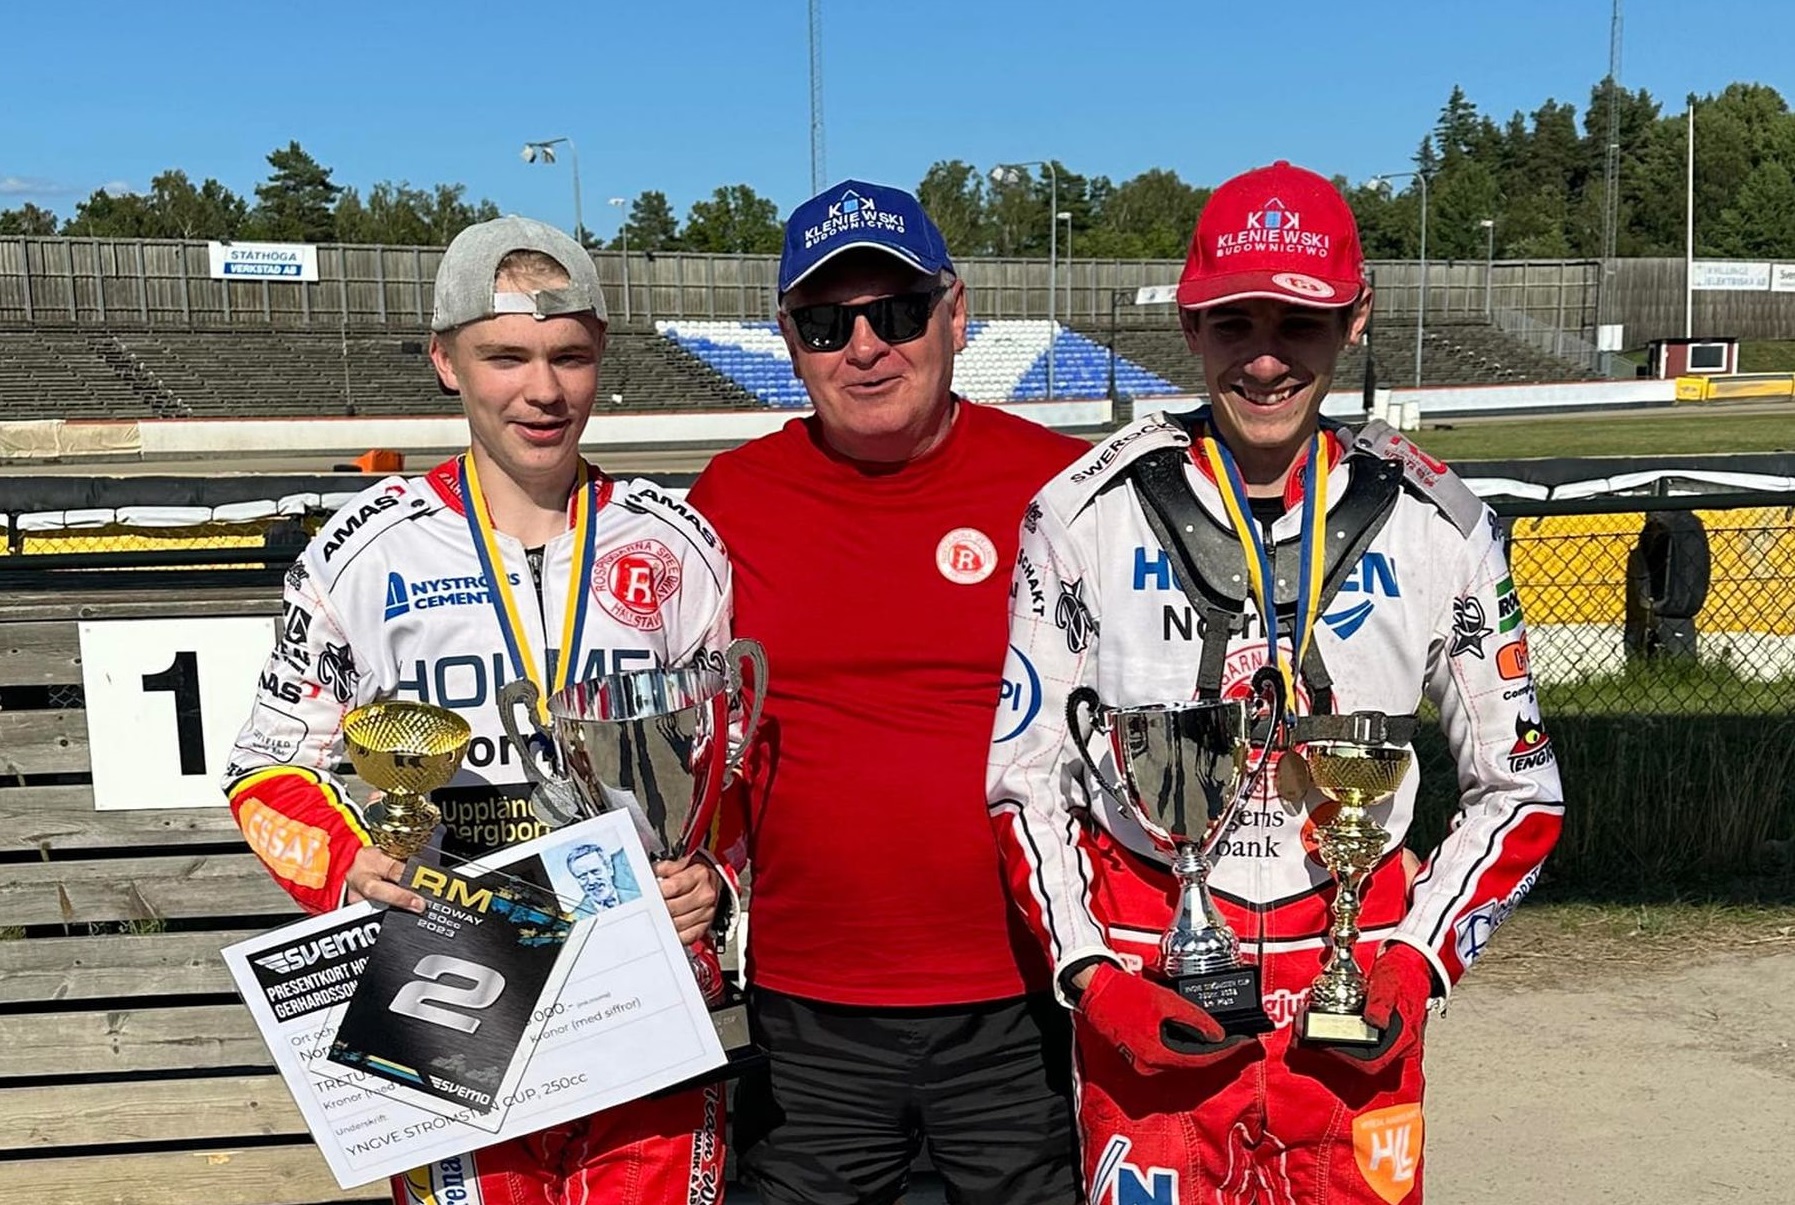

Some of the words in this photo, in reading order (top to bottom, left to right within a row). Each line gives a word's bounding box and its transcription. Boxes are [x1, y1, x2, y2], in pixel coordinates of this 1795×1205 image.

[805, 211, 904, 241] KLENIEWSKI
[805, 221, 905, 249] BUDOWNICTWO
[1217, 229, 1329, 249] KLENIEWSKI
[1216, 243, 1328, 258] BUDOWNICTWO
[231, 264, 282, 274] VERKSTAD
[322, 494, 399, 563] AMAS
[638, 488, 717, 549] AMAS
[142, 651, 207, 776] 1
[410, 865, 494, 914] RM
[427, 900, 485, 926] EDWAY
[416, 918, 456, 939] 2023
[266, 962, 350, 1002] PRESENTKORT
[388, 953, 506, 1035] 2
[604, 996, 642, 1018] siffror)
[313, 1071, 375, 1093] TRETU
[323, 1093, 362, 1110] Kronor
[345, 1130, 401, 1157] YNGVE
[541, 1073, 589, 1096] 250cc
